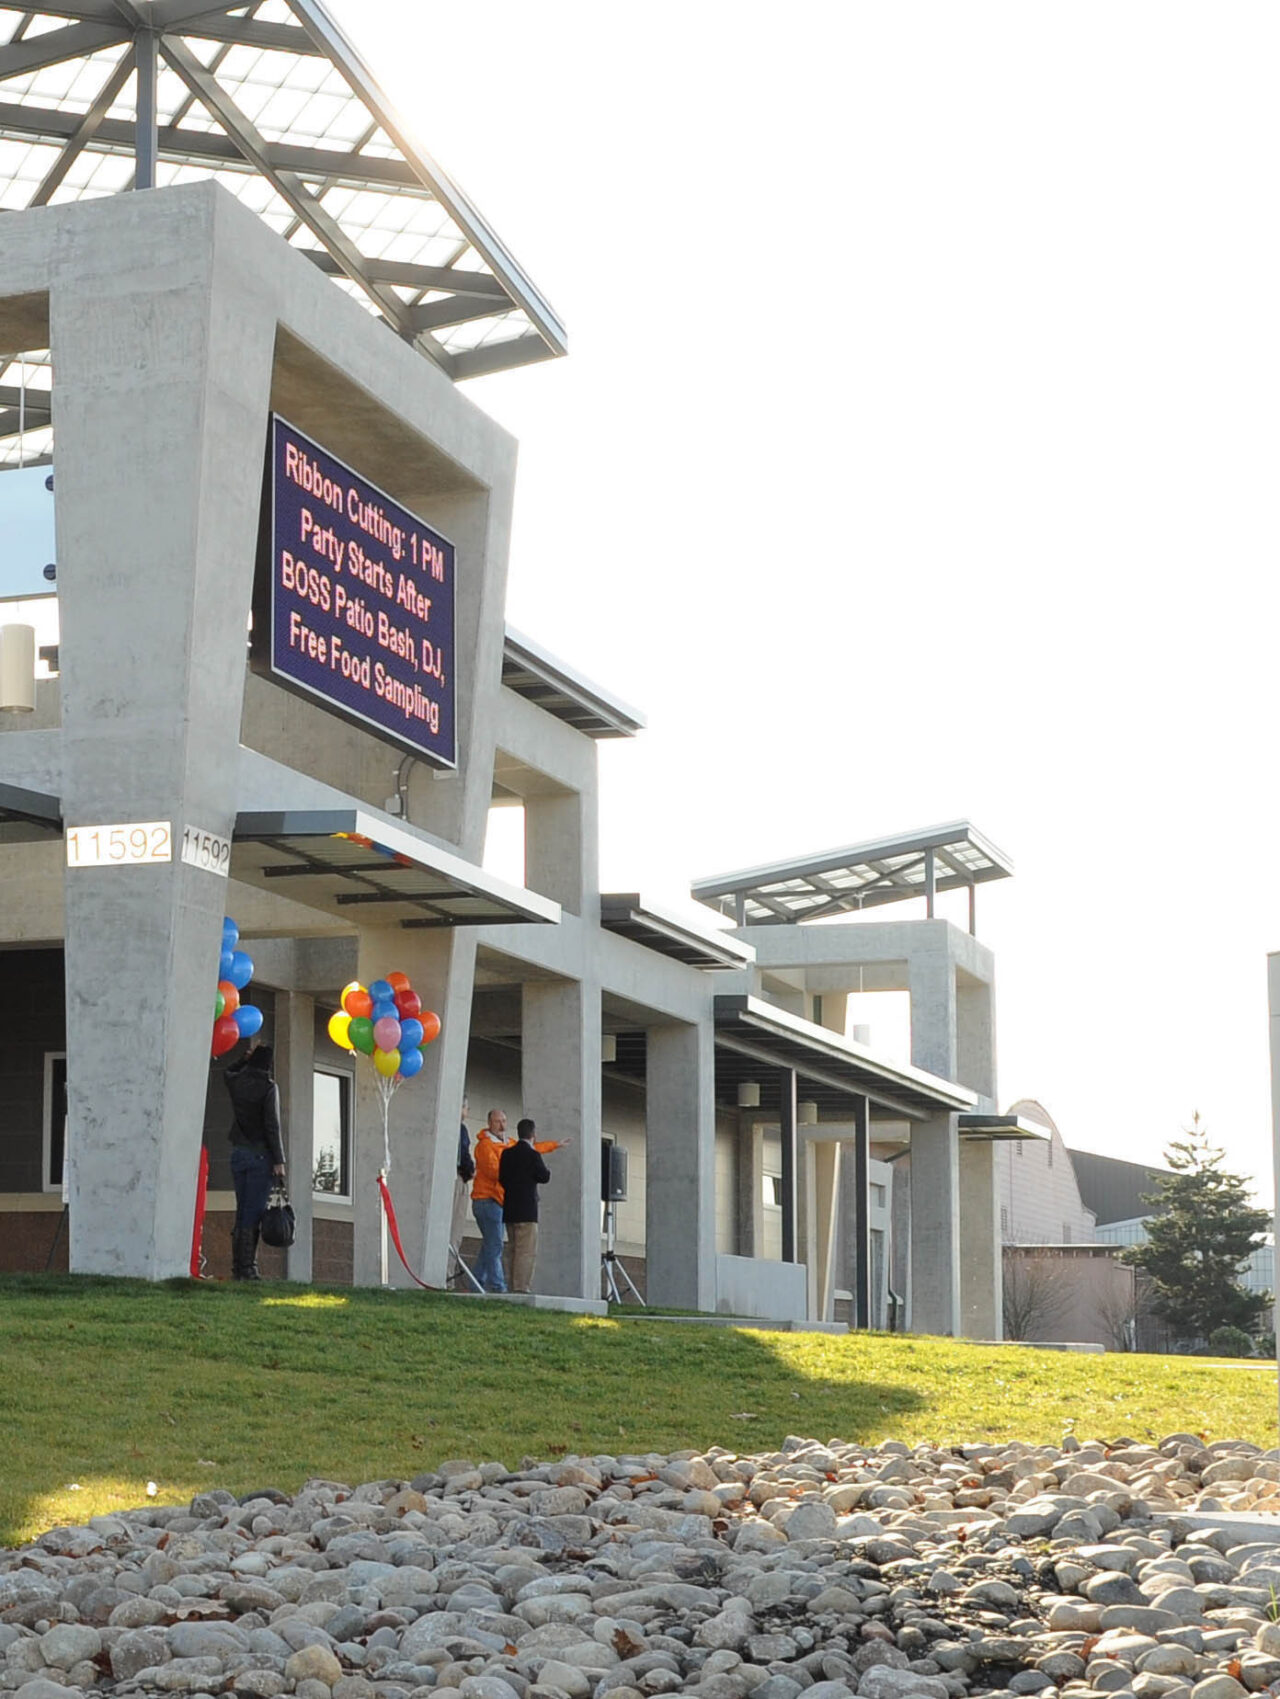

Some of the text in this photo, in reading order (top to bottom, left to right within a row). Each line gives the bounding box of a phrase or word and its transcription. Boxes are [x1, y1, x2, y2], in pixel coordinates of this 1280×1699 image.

[285, 442, 444, 582] Ribbon Cutting: 1 PM
[300, 508, 431, 622] Party Starts After
[281, 551, 445, 688] BOSS Patio Bash, DJ,
[289, 611, 438, 734] Free Food Sampling
[70, 827, 169, 861] 11592
[184, 829, 229, 872] 11592
